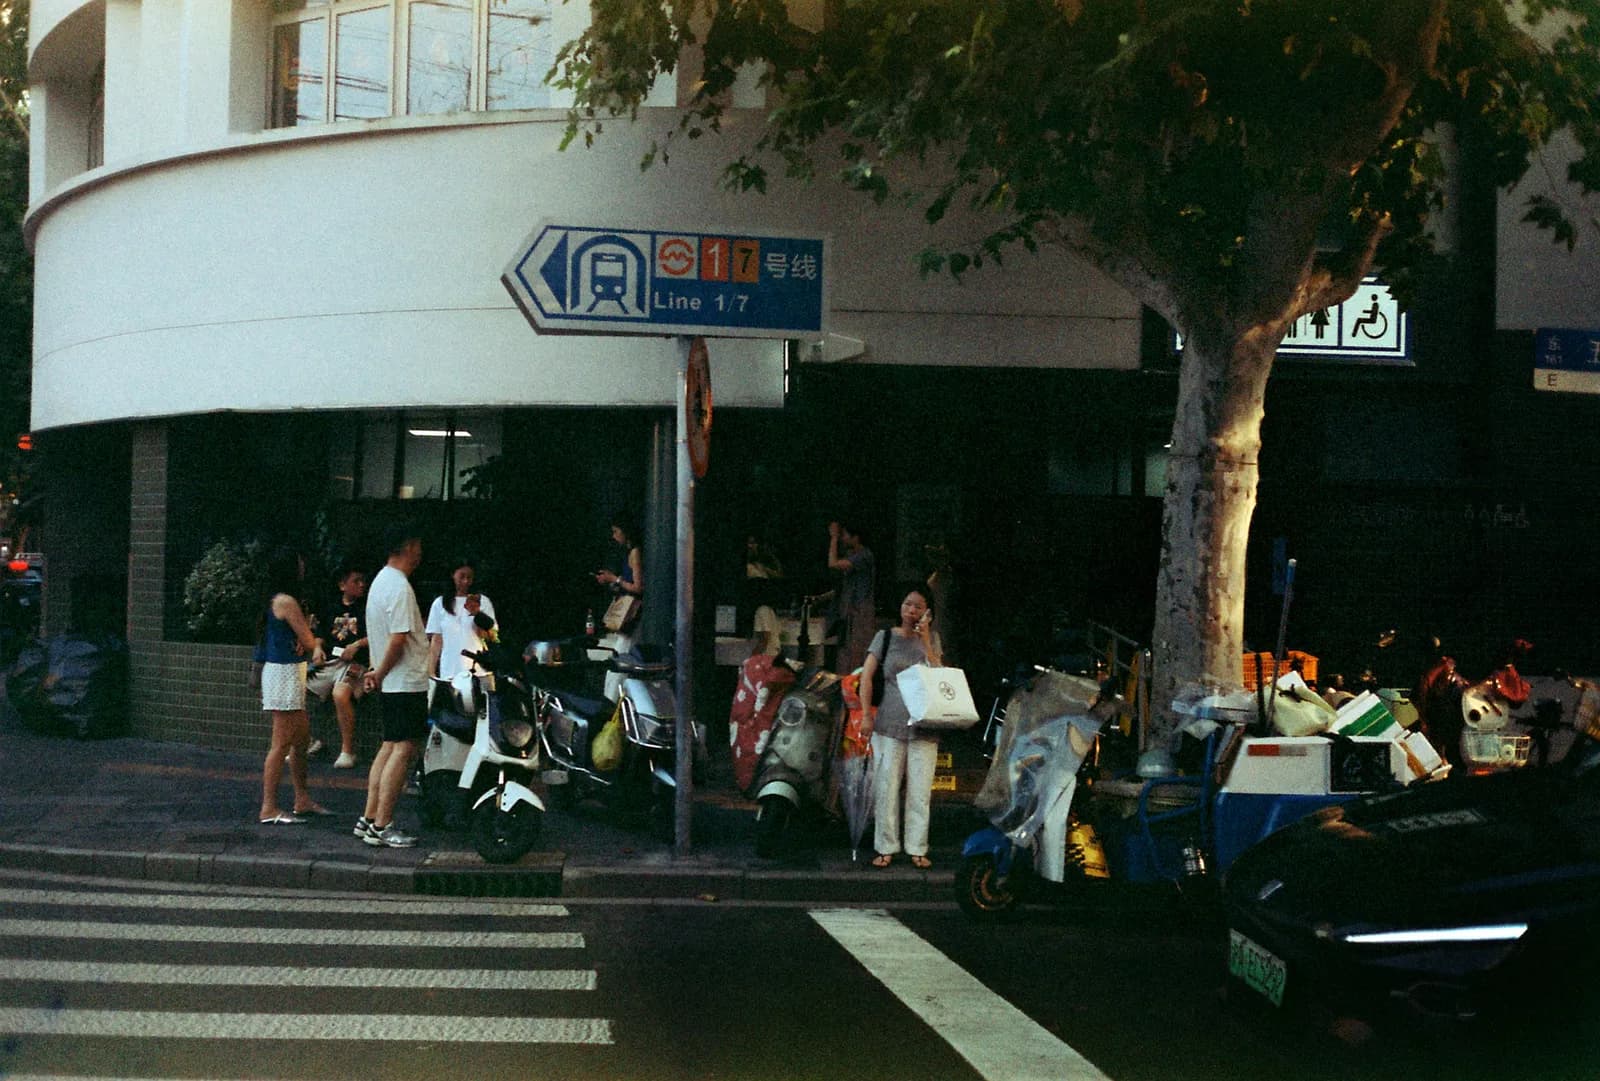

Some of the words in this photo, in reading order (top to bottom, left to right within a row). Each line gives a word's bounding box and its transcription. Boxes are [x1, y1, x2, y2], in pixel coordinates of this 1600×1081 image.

[708, 242, 720, 278] 1
[737, 247, 753, 274] 7
[764, 252, 817, 280] 号线
[654, 291, 702, 311] Line
[714, 293, 750, 313] 1/7
[1547, 373, 1558, 387] E
